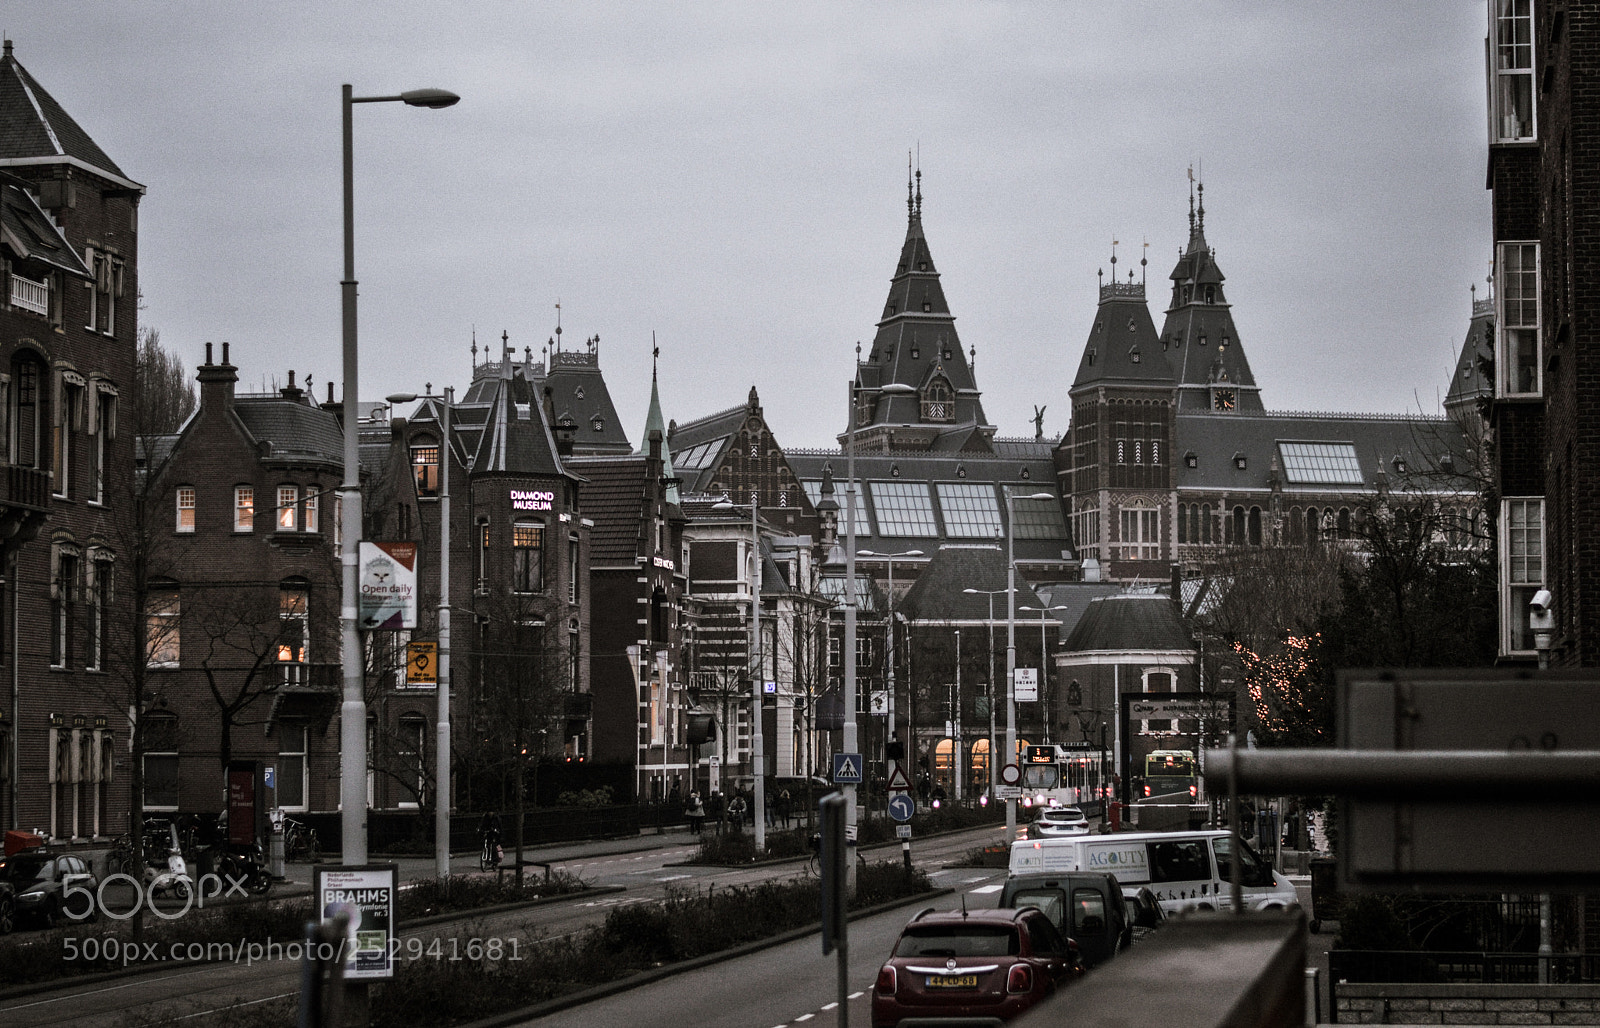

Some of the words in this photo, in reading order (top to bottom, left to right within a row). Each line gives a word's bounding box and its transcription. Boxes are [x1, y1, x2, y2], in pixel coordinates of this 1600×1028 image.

[510, 490, 554, 501] DIAMOND
[513, 500, 552, 511] MUSEUM
[362, 584, 388, 595] Open
[389, 584, 412, 595] daily
[1089, 850, 1146, 866] AGOUTY
[325, 889, 389, 904] BRAHMS
[357, 903, 388, 912] Symfonie
